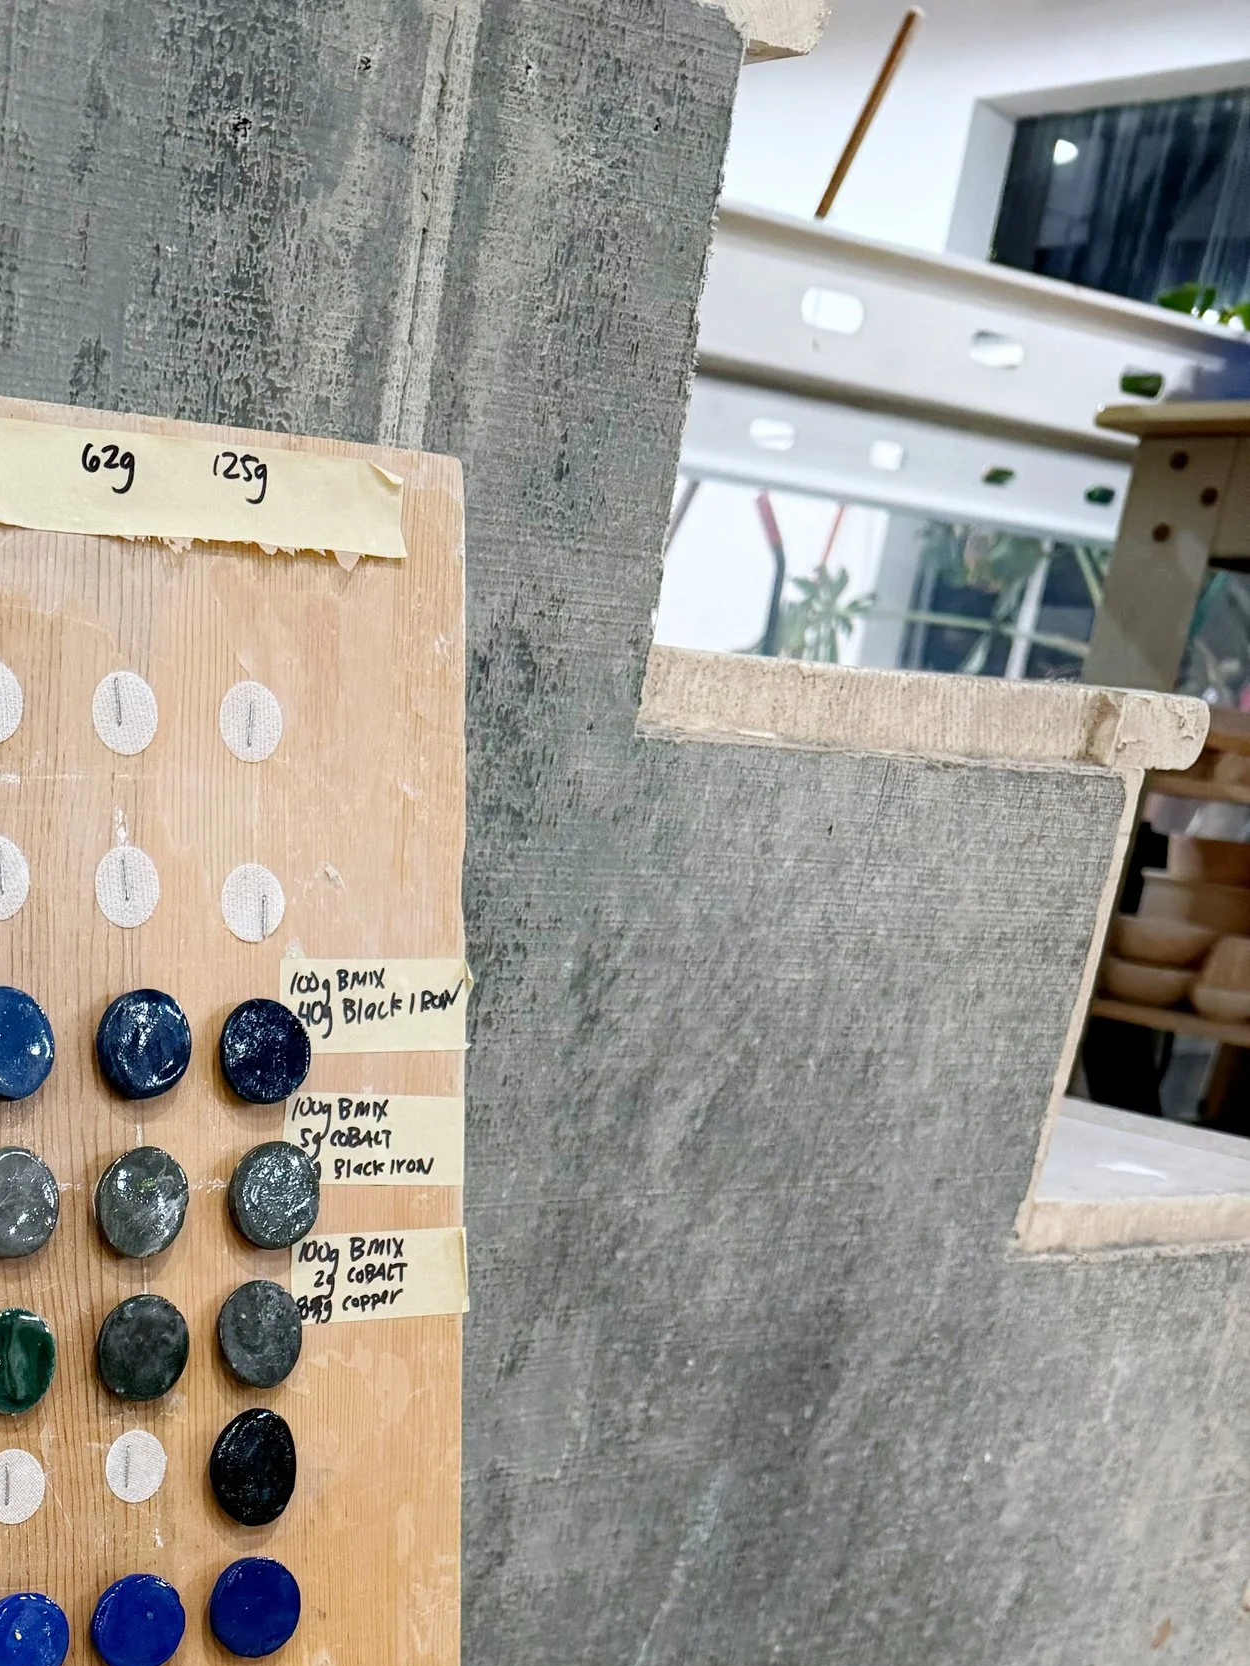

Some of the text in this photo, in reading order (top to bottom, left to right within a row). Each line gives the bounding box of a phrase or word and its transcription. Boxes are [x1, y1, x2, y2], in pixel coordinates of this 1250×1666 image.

[81, 441, 136, 493] 62g
[212, 452, 269, 504] 125g
[289, 968, 386, 1001] 100g BMIX
[342, 992, 403, 1024] Black
[338, 1097, 389, 1123] BMIX
[298, 1236, 404, 1278] 100g BMIX
